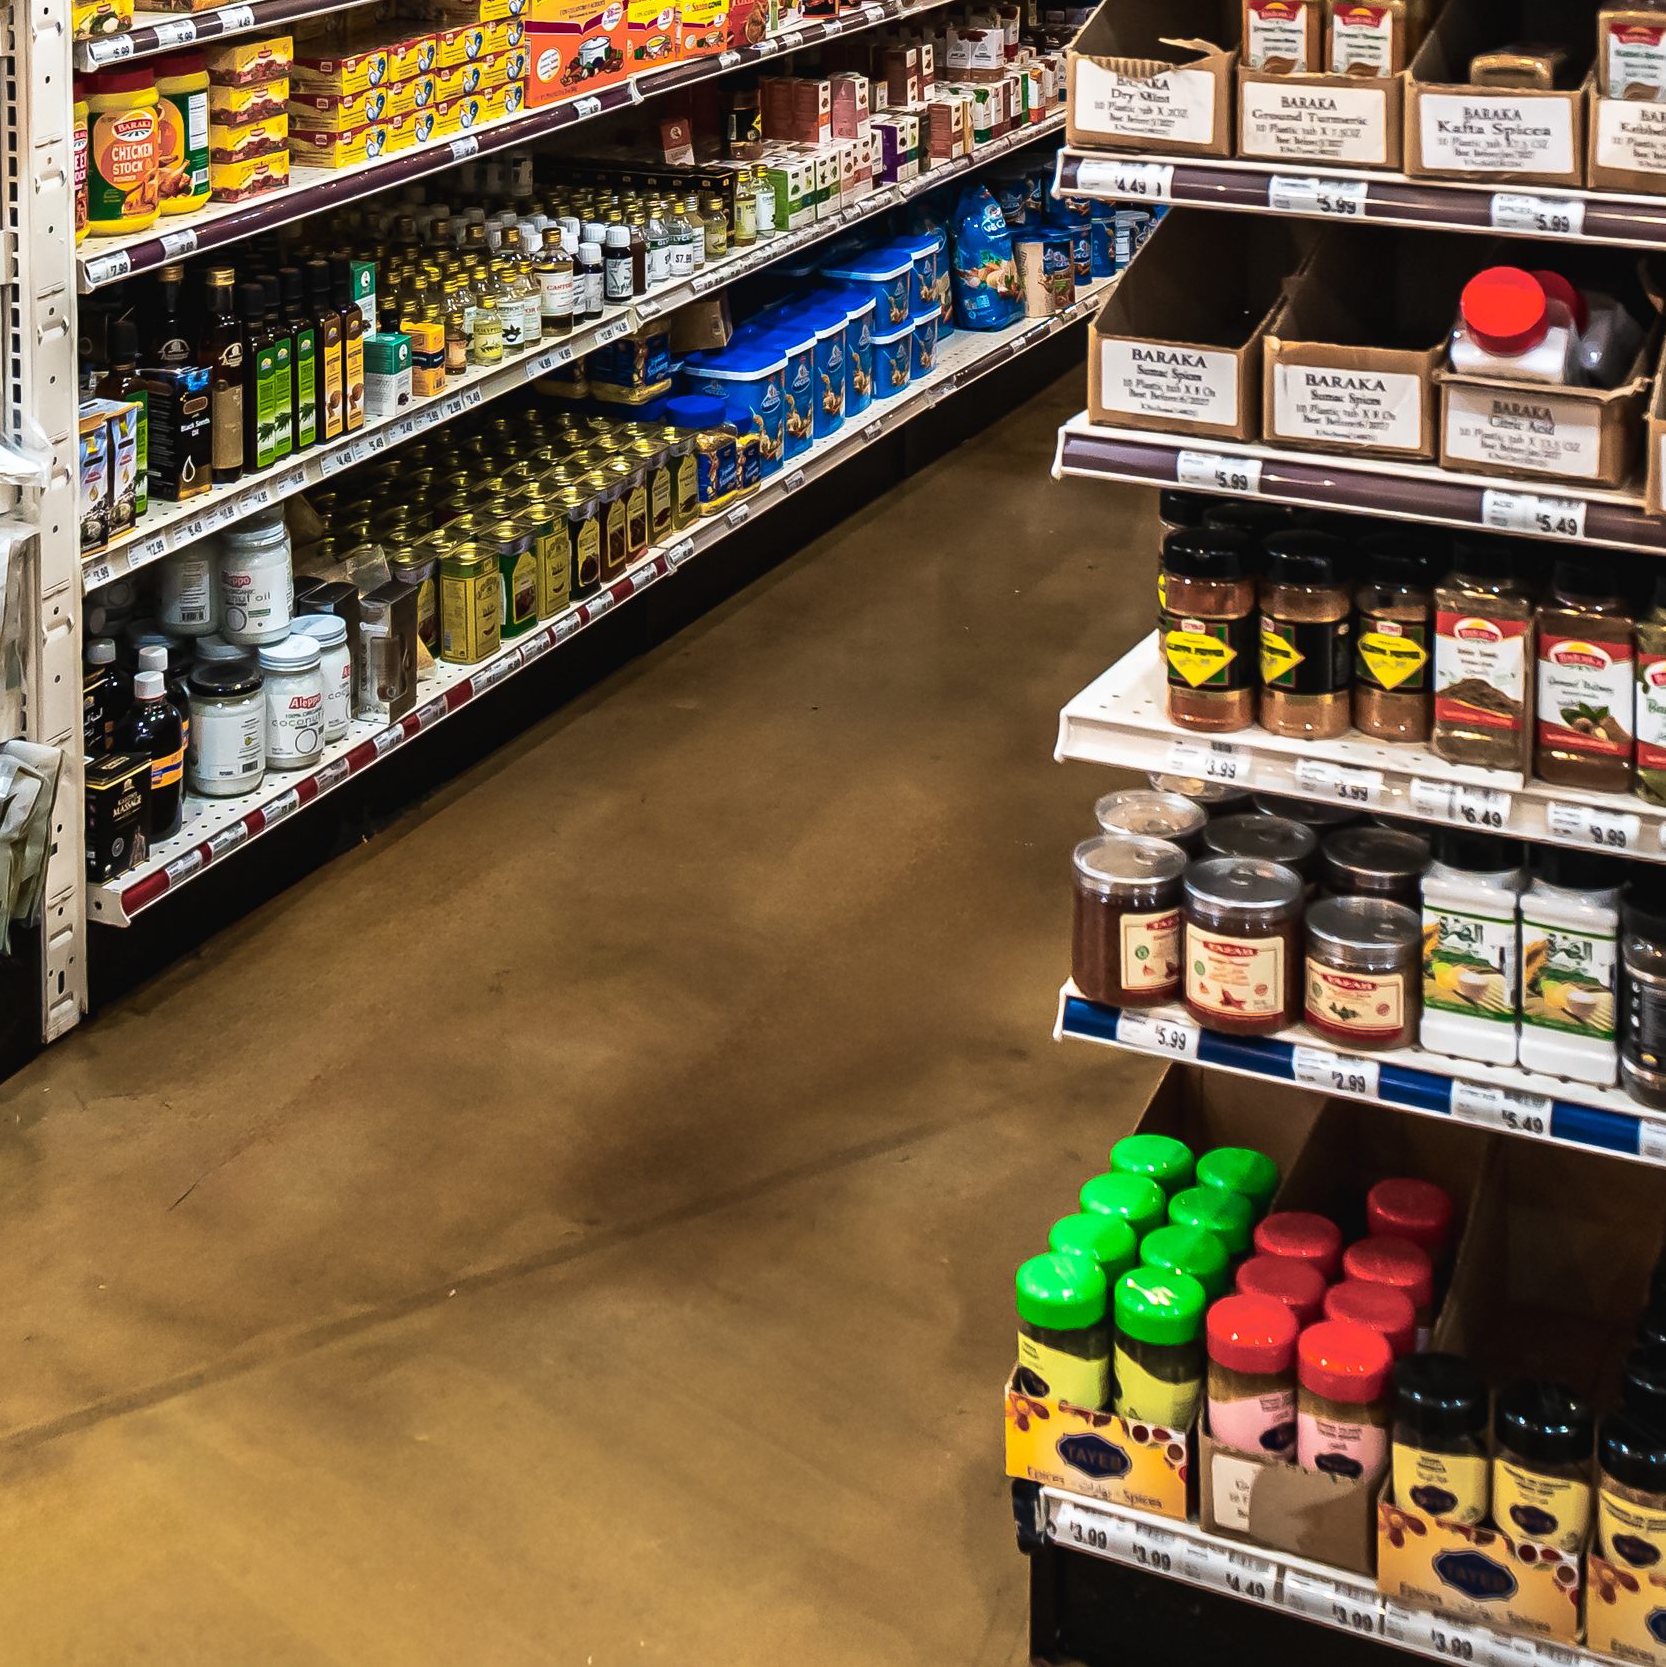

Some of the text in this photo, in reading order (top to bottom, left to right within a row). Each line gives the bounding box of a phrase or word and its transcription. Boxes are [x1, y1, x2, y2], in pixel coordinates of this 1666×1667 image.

[708, 0, 721, 8] GOYA
[111, 143, 153, 159] CHICKEN
[113, 161, 143, 174] STOCK
[1130, 348, 1207, 368] BARAKA
[1136, 365, 1202, 382] Sumac Spices
[1305, 374, 1386, 392] BARAKA
[1310, 390, 1382, 407] Sumac Spices
[1493, 400, 1554, 420] BARAKA
[290, 696, 321, 709] Aleppo
[112, 794, 143, 816] MASSAGE
[1059, 1443, 1131, 1473] TAYEB
[1436, 1559, 1515, 1595] TAYEB
